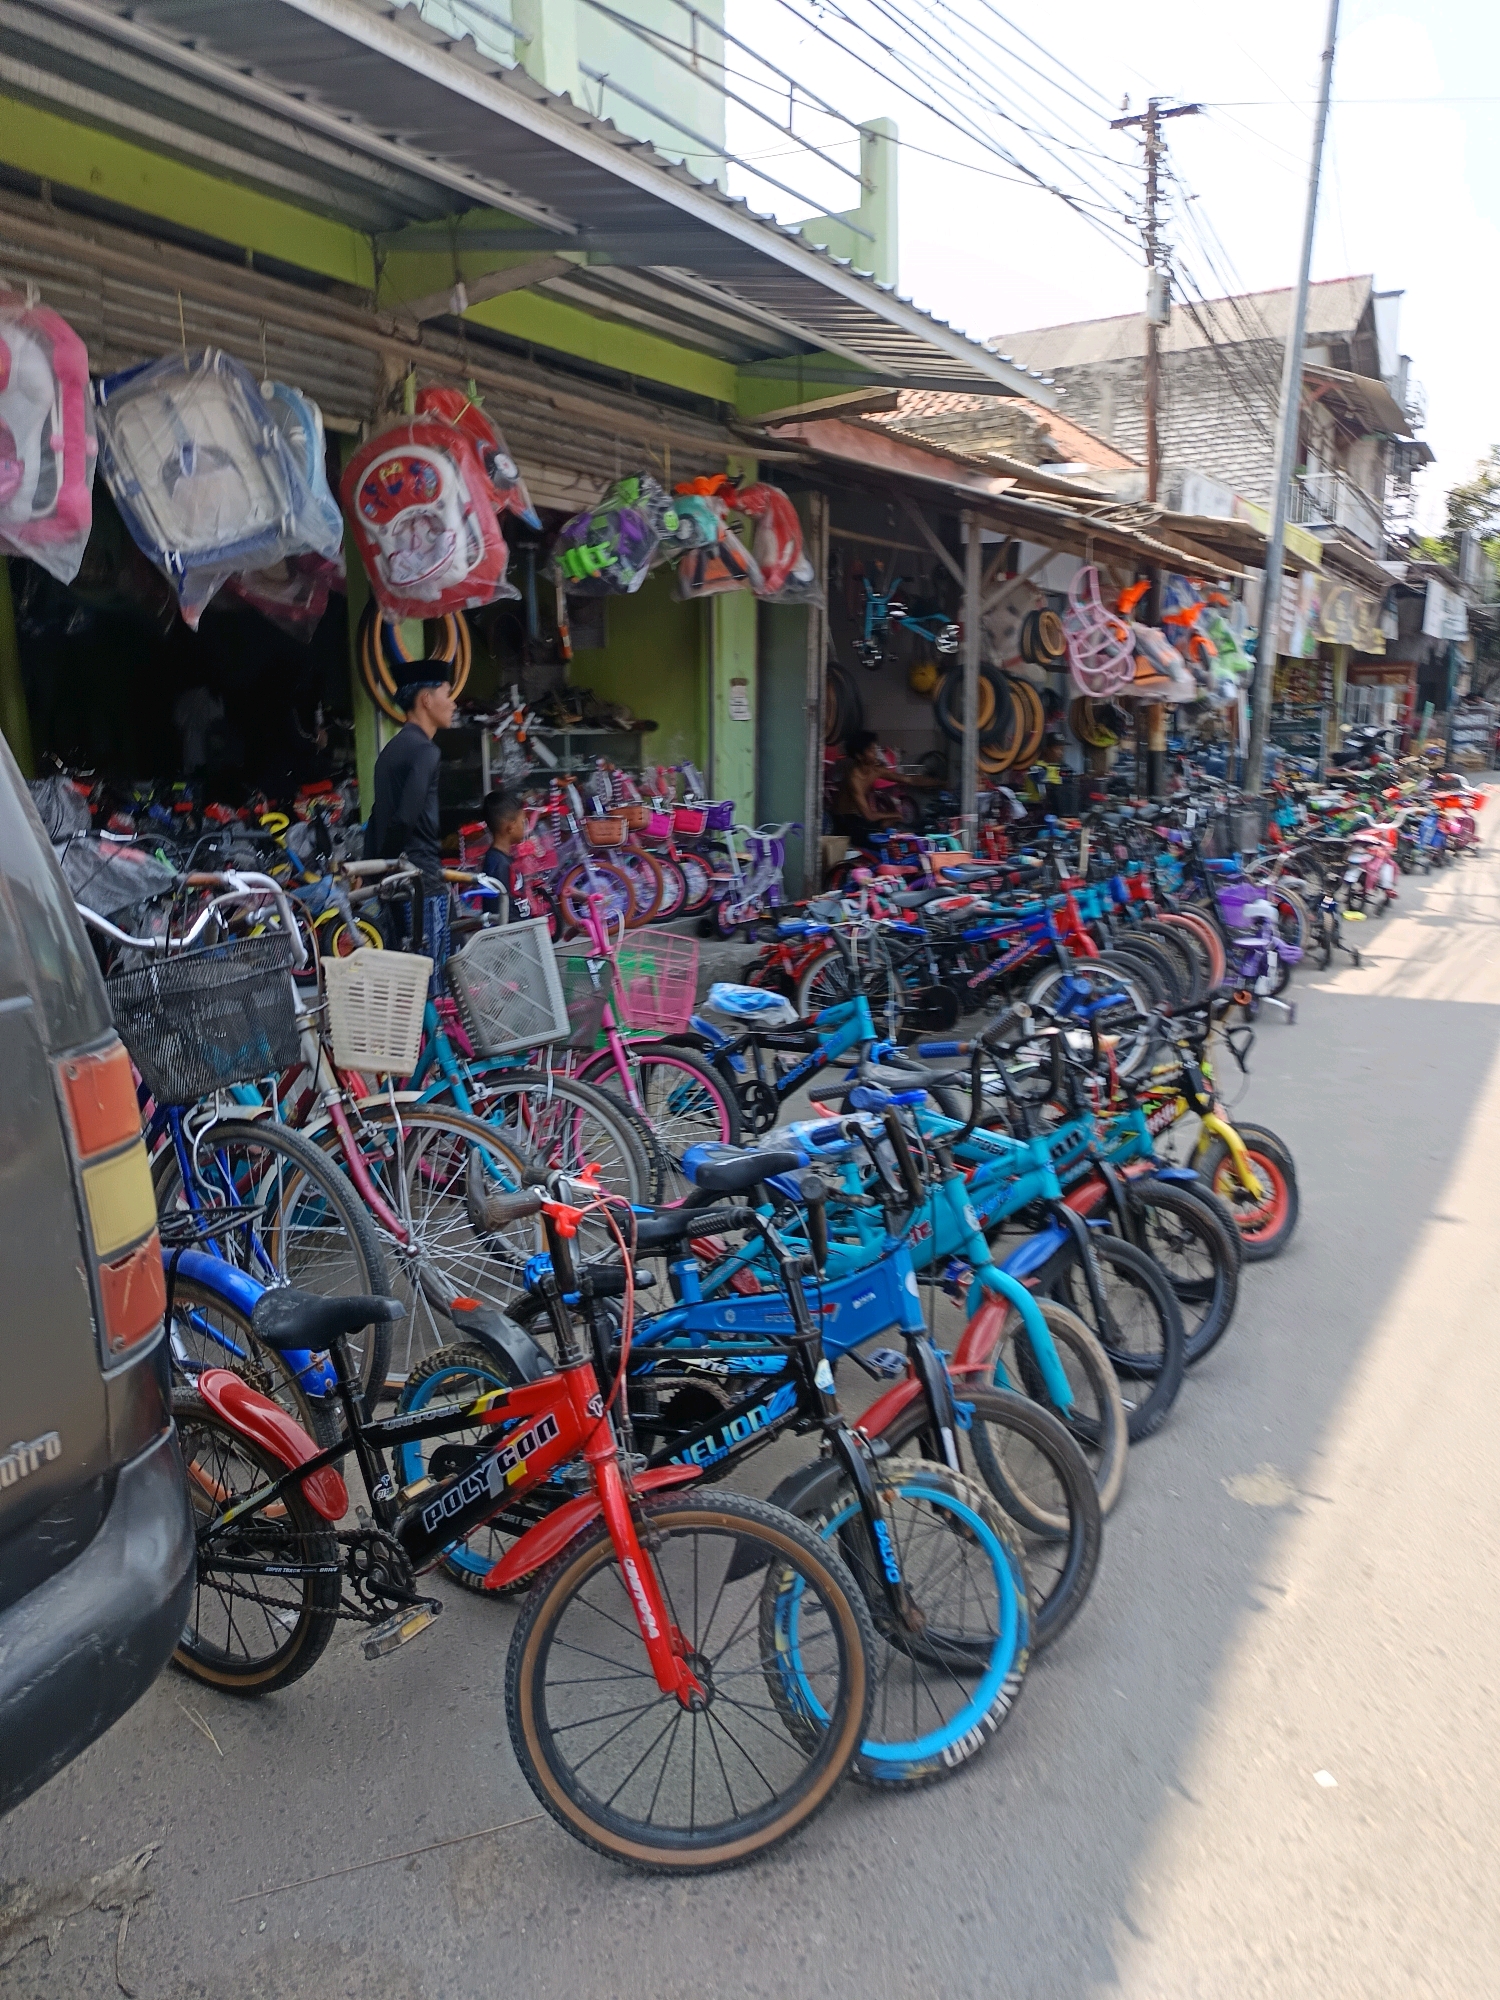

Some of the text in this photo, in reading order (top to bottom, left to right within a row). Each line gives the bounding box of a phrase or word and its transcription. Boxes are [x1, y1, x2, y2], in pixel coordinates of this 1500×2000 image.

[669, 1404, 773, 1465] VELION
[422, 1412, 561, 1534] POLYGON
[495, 1511, 522, 1525] PORT
